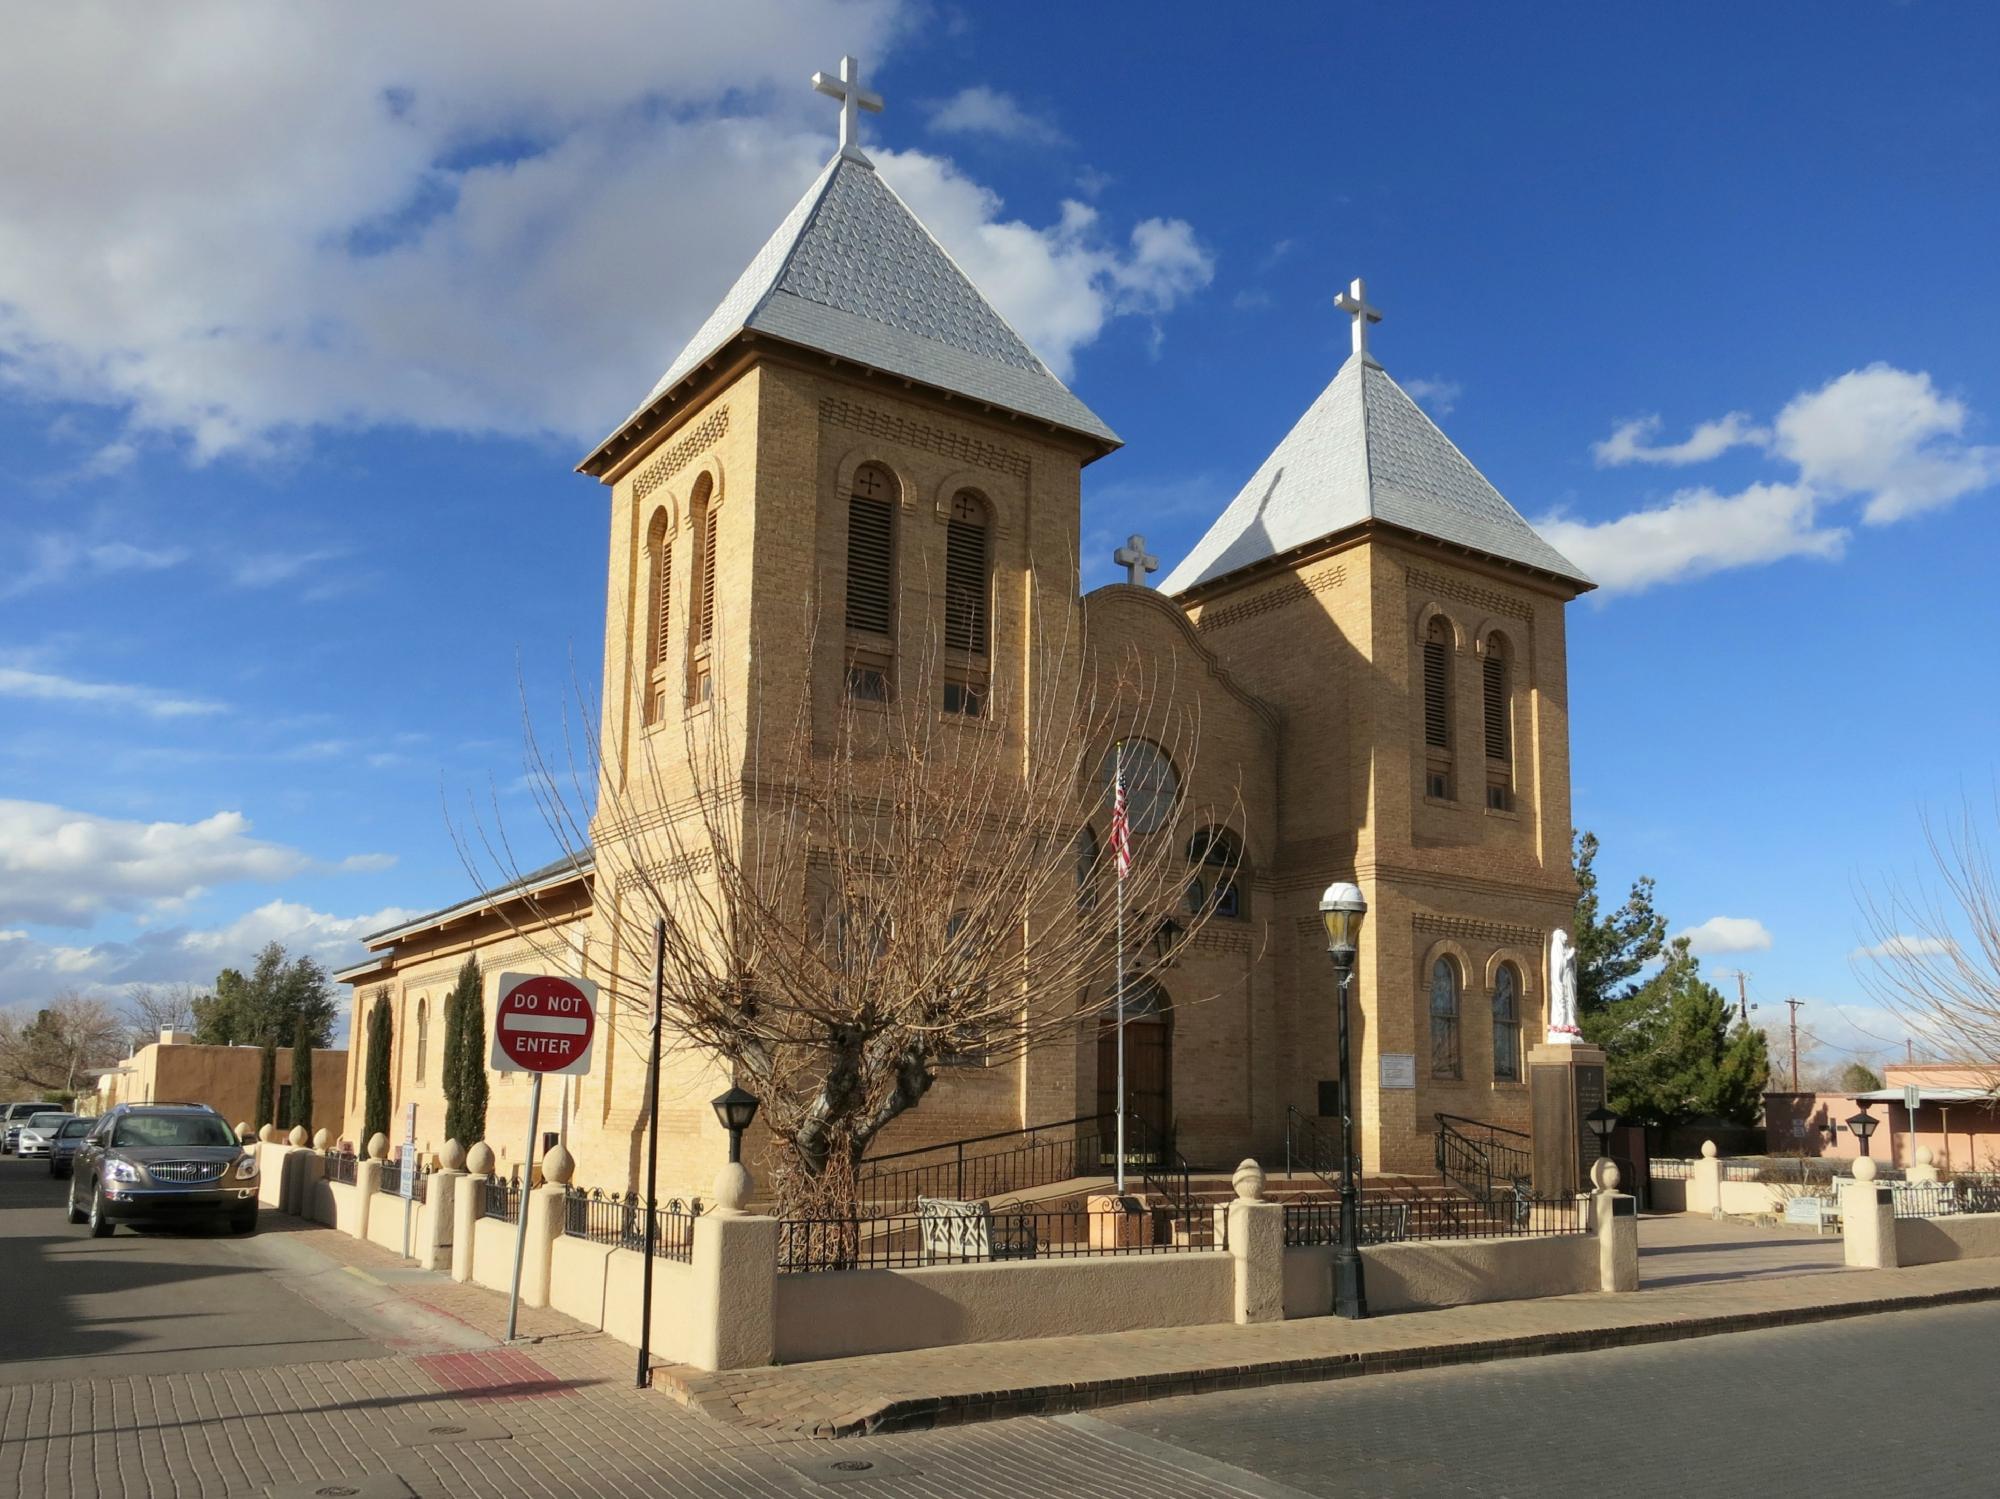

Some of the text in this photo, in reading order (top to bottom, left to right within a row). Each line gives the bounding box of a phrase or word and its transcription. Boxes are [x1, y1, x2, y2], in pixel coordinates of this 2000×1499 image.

[514, 993, 582, 1013] DO NOT
[515, 1037, 570, 1054] ENTER
